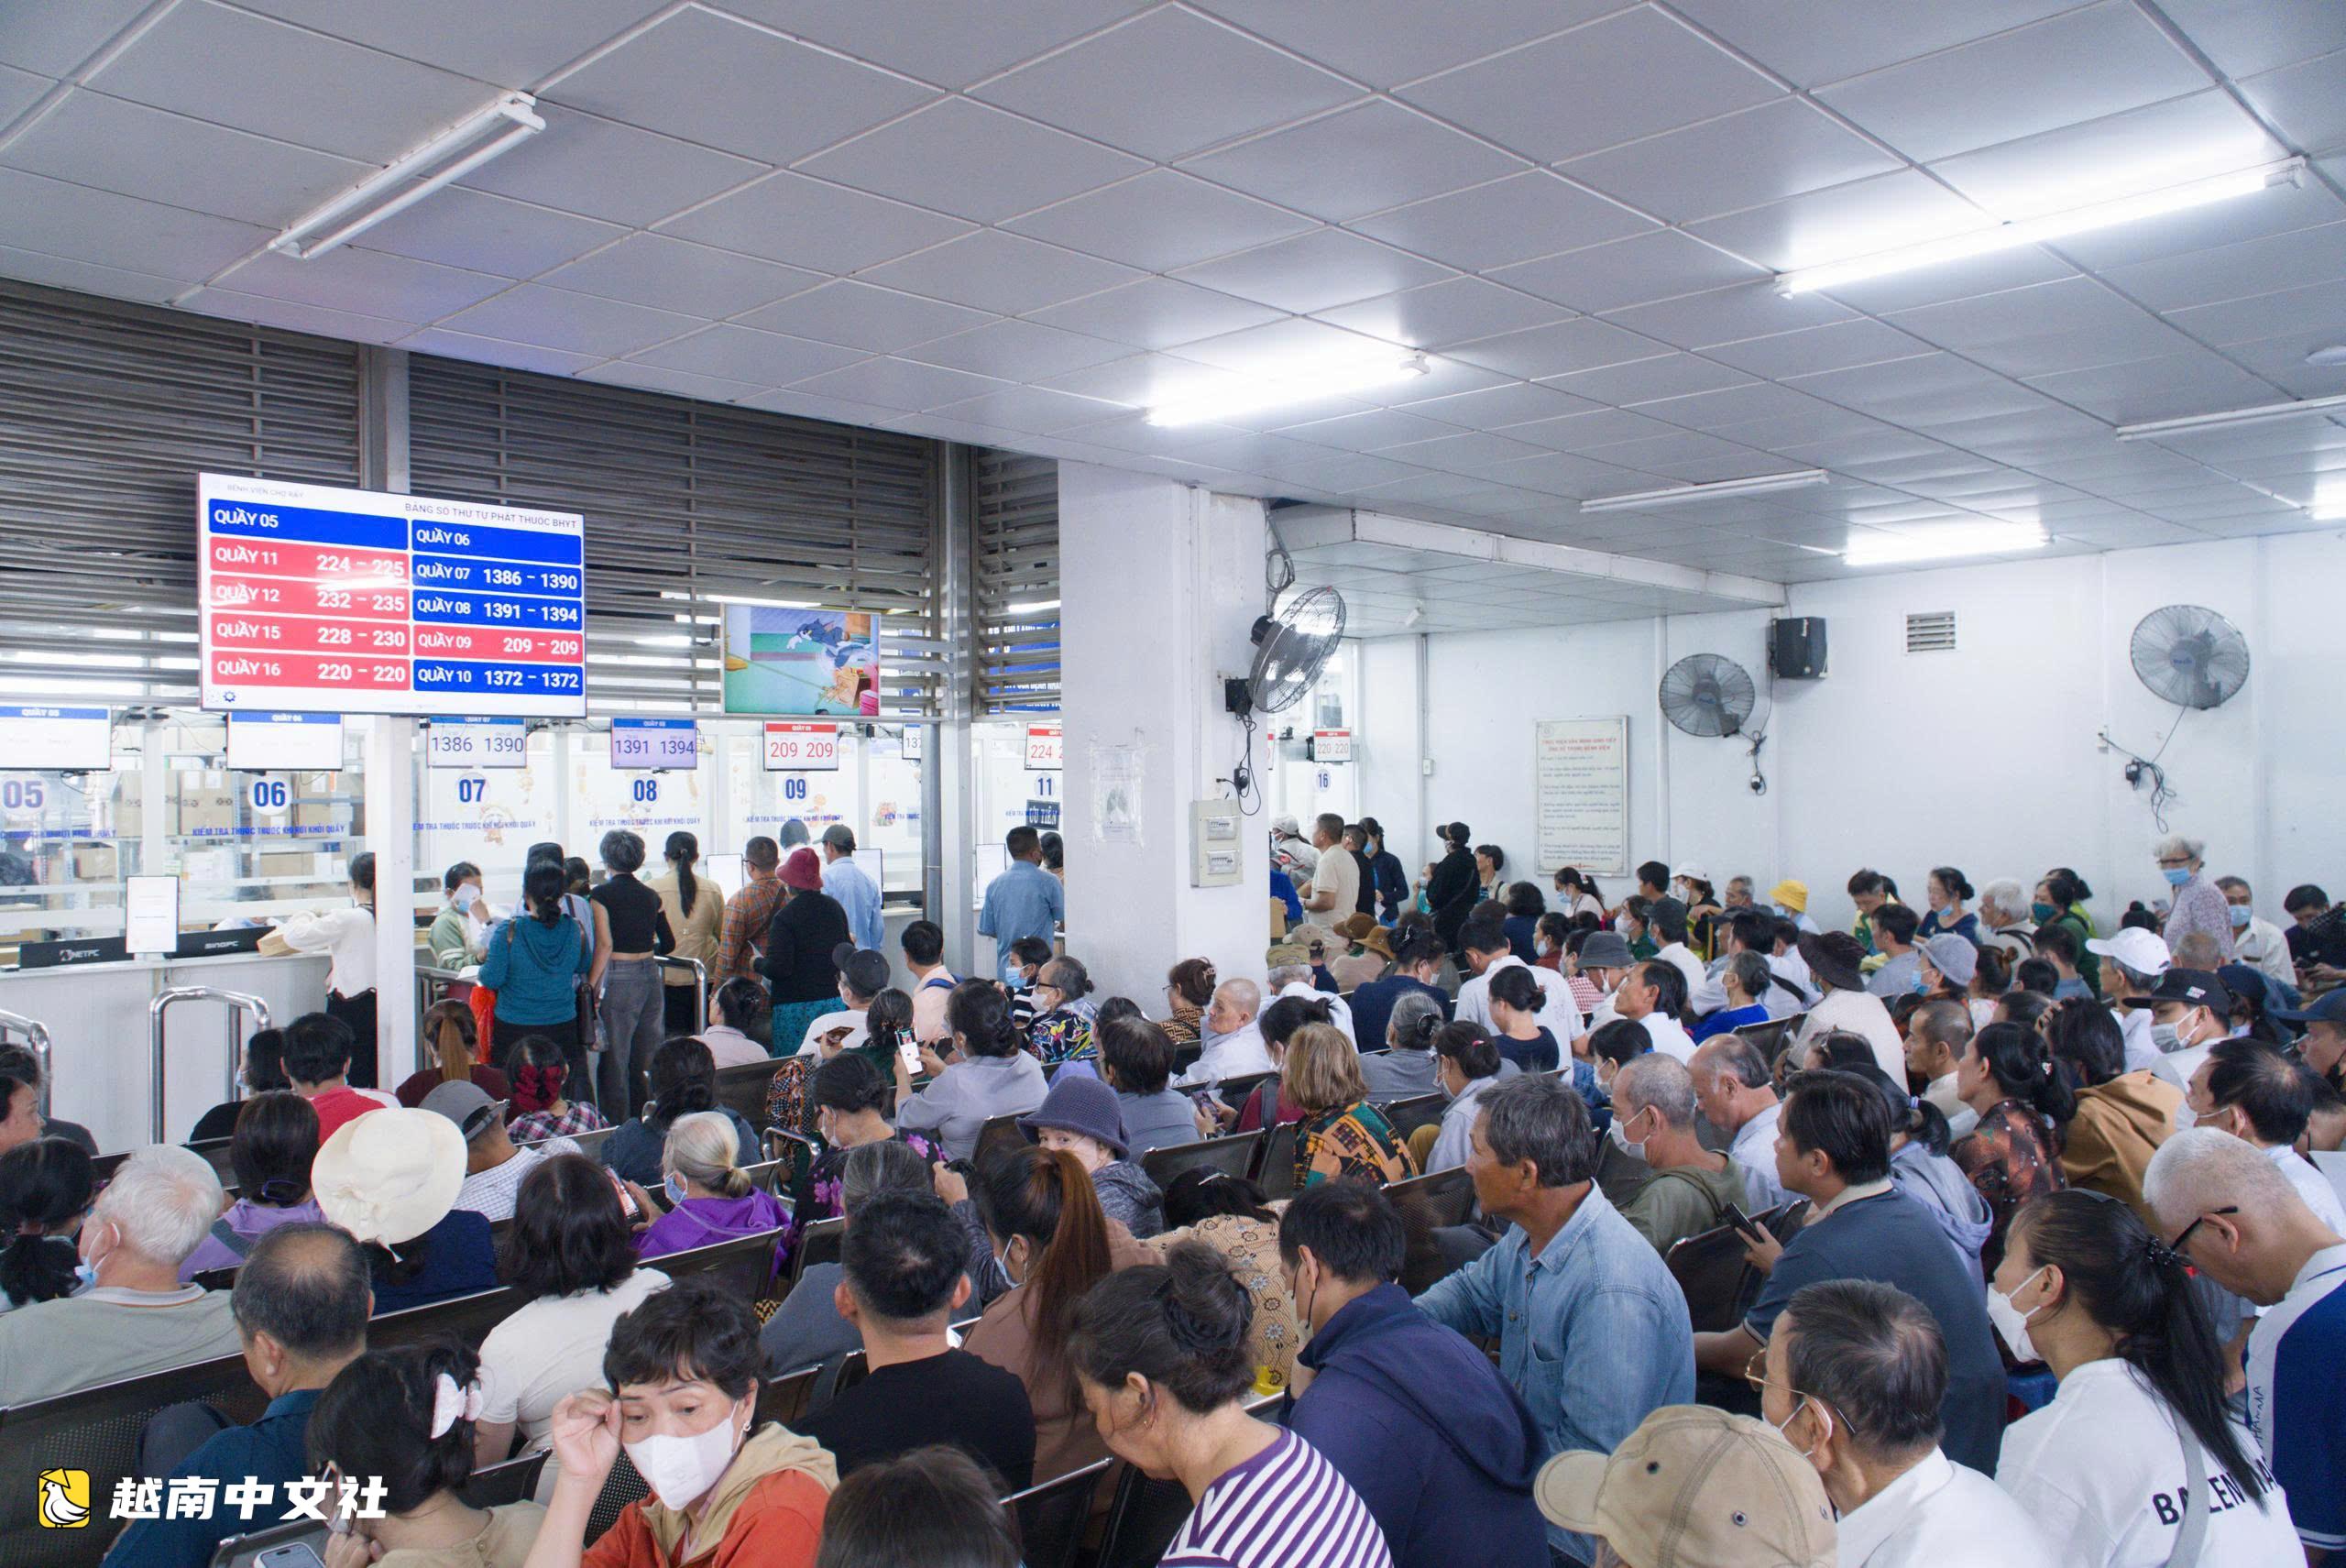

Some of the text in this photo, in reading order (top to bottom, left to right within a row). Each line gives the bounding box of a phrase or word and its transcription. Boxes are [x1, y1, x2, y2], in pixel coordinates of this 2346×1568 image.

[214, 508, 279, 528] QUẦY 05
[553, 519, 577, 529] BHYT
[416, 528, 470, 546] QUẦY 06
[215, 545, 258, 564] QUẦY
[261, 551, 278, 565] 11
[316, 554, 350, 572] 224
[372, 559, 404, 576] 225
[416, 562, 453, 579] QUẦY
[455, 567, 471, 580] 07
[483, 568, 522, 586] 1386
[541, 573, 577, 589] 1390
[216, 583, 258, 602] QUẦY
[262, 588, 280, 602] 12
[316, 591, 351, 609] 232
[372, 595, 405, 611] 235
[417, 597, 454, 613] QUẦY
[455, 601, 471, 614] 08
[483, 602, 521, 619] 1391
[541, 607, 578, 622] 1394
[216, 620, 259, 638] QUẦY
[262, 626, 281, 640] 15
[317, 627, 352, 644] 228
[373, 630, 406, 647] 230
[418, 631, 455, 648] QUẦY
[455, 636, 472, 649] 09
[503, 638, 532, 652] 209
[551, 640, 578, 655] 209
[216, 658, 260, 675] QUẦY
[262, 663, 281, 676] 16
[317, 663, 352, 681] 220
[373, 666, 406, 682] 220
[418, 665, 455, 683] QUẦY
[456, 671, 472, 683] 10
[484, 671, 523, 686] 1372
[542, 673, 579, 688] 1372
[432, 737, 524, 752] 1386 1390
[615, 740, 695, 754] 1391 1394
[770, 742, 833, 758] 209 209
[1031, 744, 1052, 759] 224
[1317, 742, 1349, 754] 220 220
[459, 779, 486, 802] 07
[633, 779, 657, 802] 08
[785, 778, 806, 800] 09
[1038, 778, 1052, 795] 11
[1318, 773, 1329, 788] 16
[3, 780, 44, 809] 05
[254, 781, 286, 807] 06
